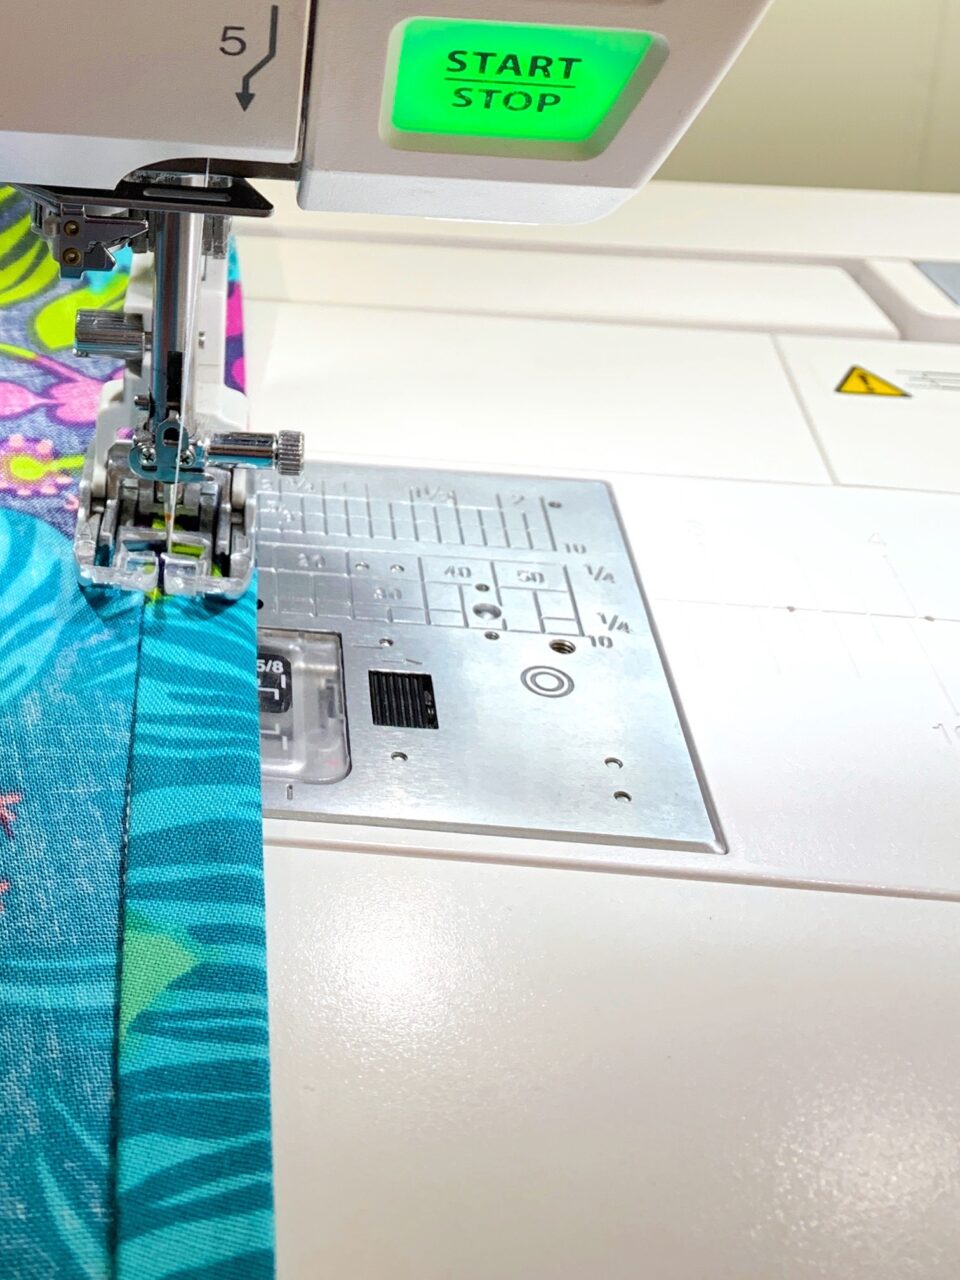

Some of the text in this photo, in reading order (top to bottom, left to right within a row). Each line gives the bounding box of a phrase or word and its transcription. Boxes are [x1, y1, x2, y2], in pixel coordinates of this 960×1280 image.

[219, 26, 247, 56] 5
[446, 50, 583, 80] START
[451, 87, 561, 113] STOP
[444, 565, 472, 579] 40
[587, 635, 614, 649] 10
